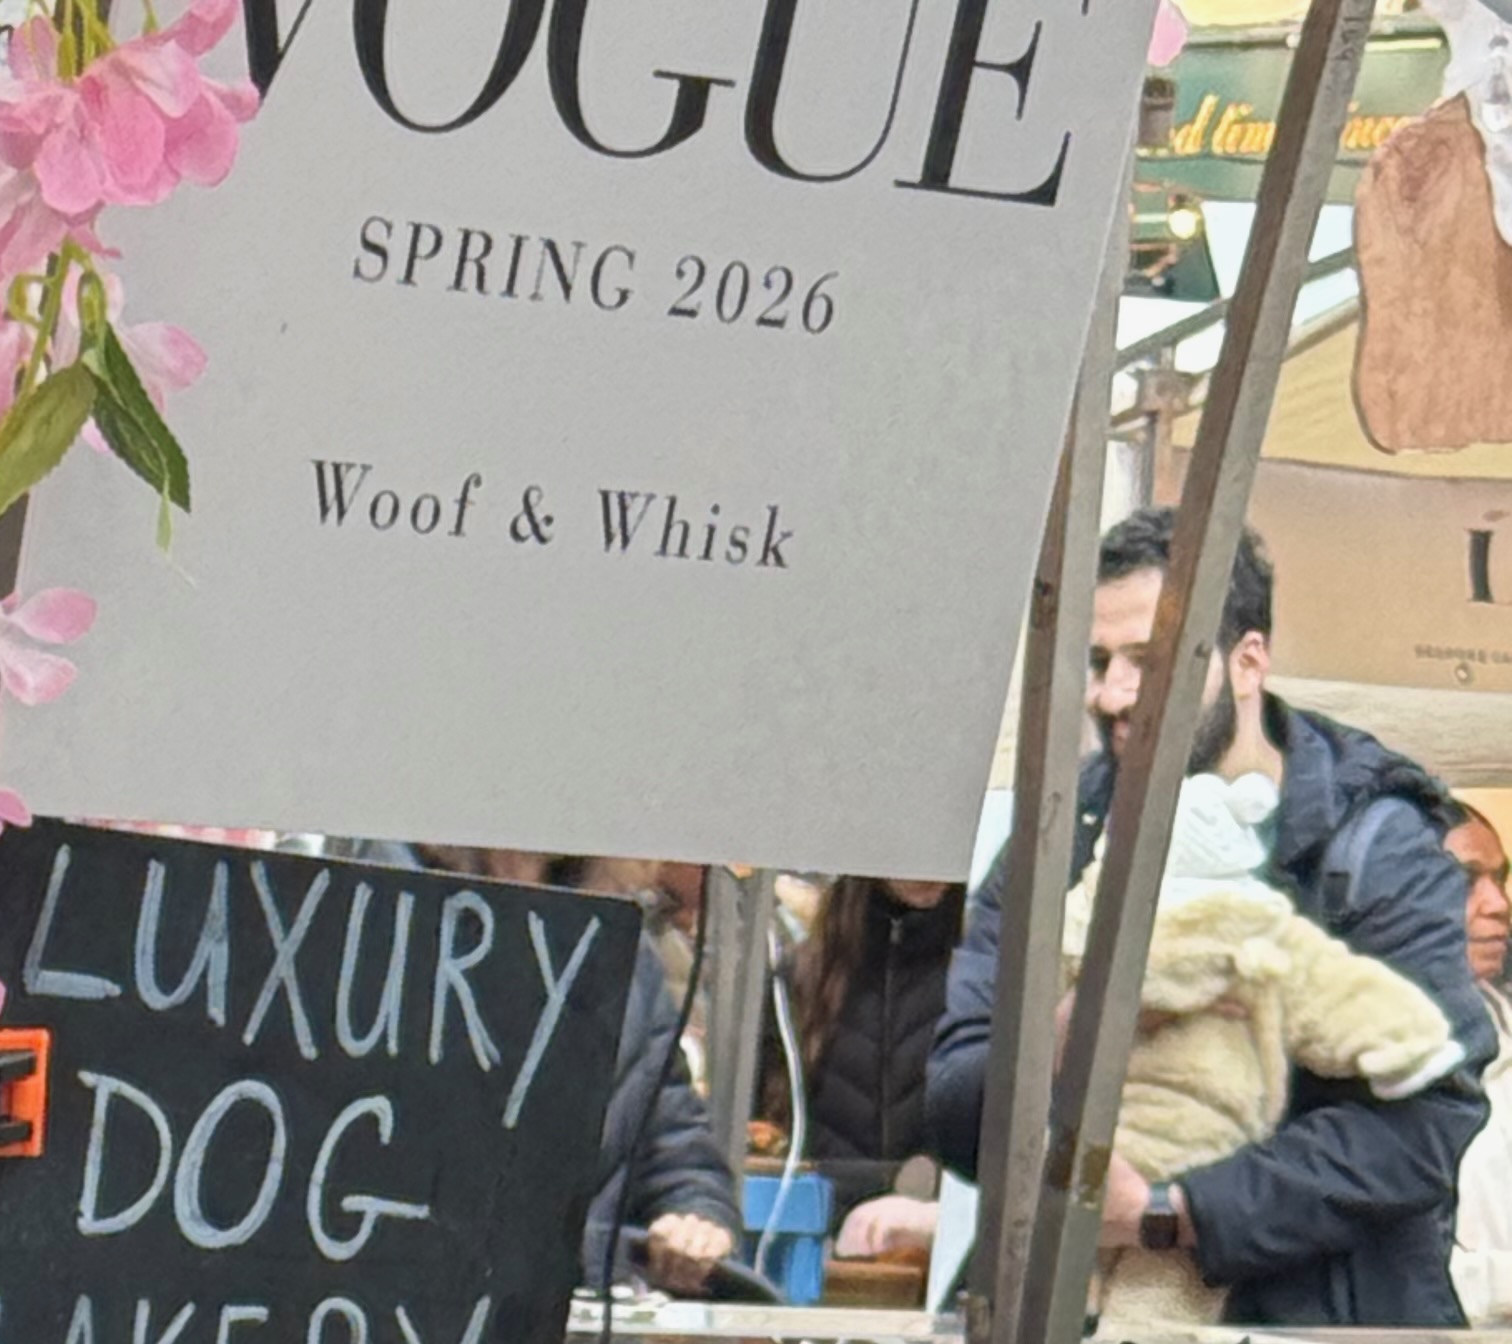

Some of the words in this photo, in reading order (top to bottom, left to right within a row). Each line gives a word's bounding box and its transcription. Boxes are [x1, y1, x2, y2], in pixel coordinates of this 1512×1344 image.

[352, 215, 638, 313] SPRING
[667, 253, 840, 336] 2026
[310, 458, 483, 541] Woof
[509, 483, 556, 548] &
[597, 488, 795, 570] Whisk
[24, 843, 602, 1128] LUXURY
[78, 1069, 430, 1261] DOG
